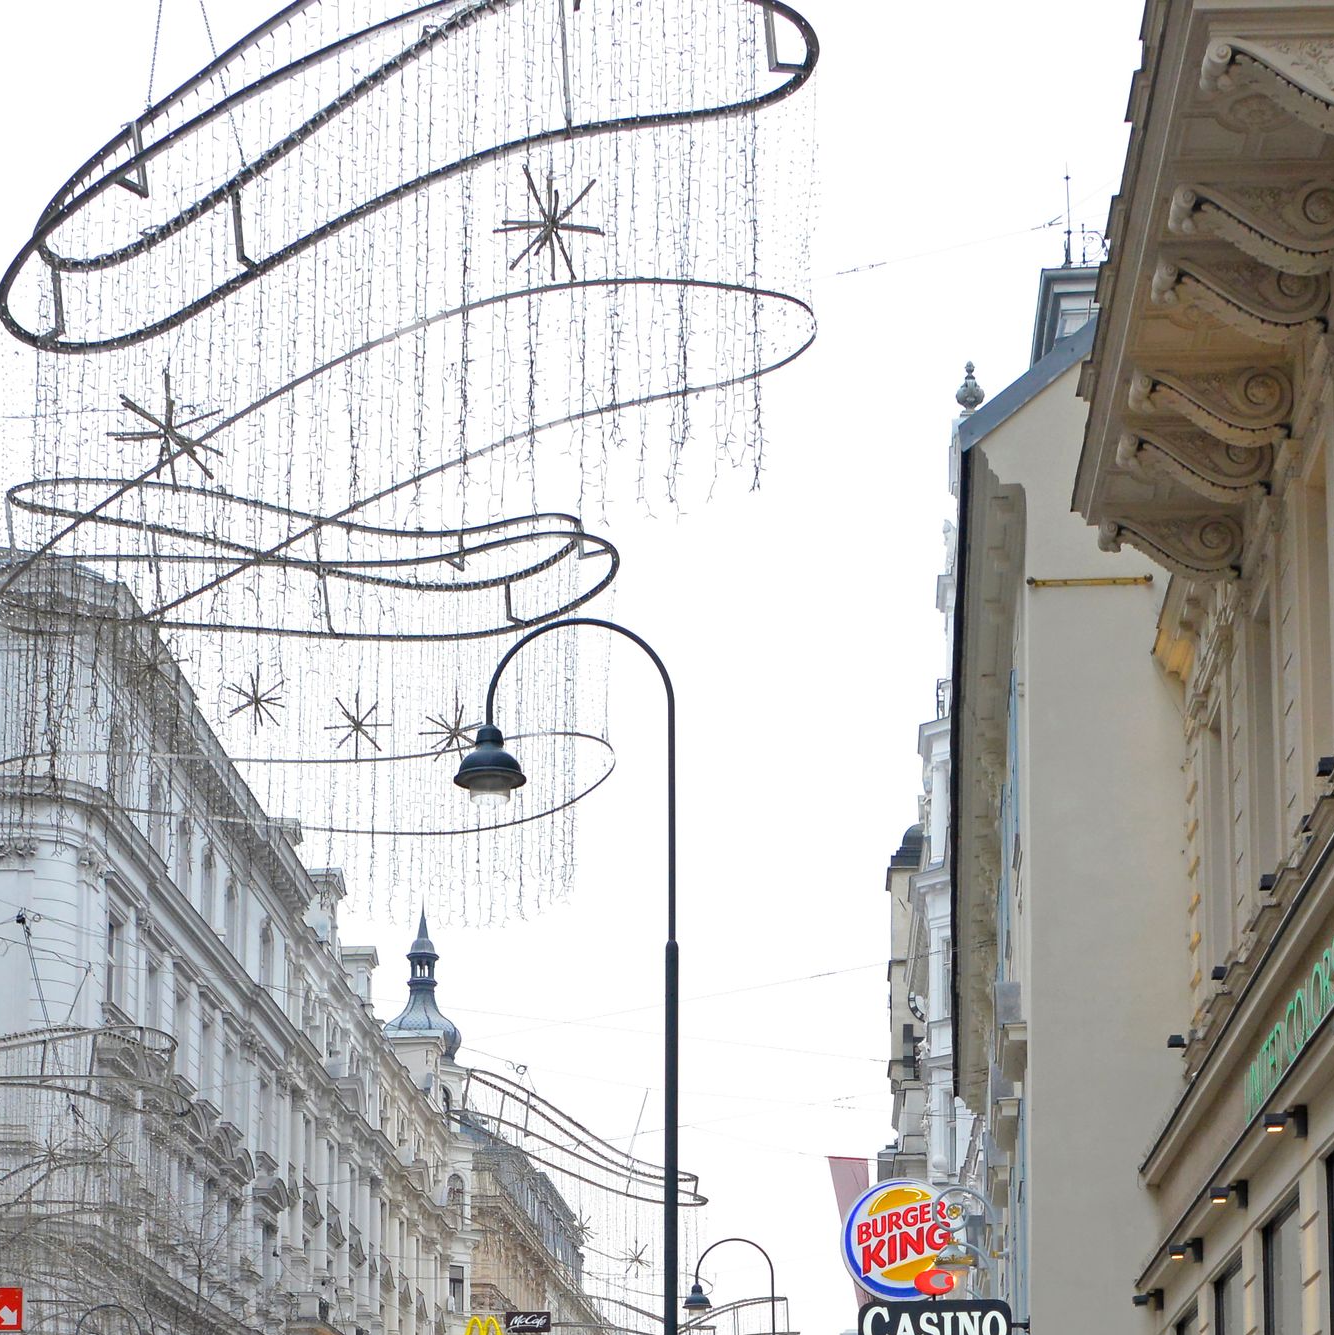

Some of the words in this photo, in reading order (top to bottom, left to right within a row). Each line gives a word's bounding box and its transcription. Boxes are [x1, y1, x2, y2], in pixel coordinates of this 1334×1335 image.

[1244, 1020, 1283, 1124] UNITED
[857, 1200, 947, 1246] BURGER
[862, 1221, 951, 1276] KING
